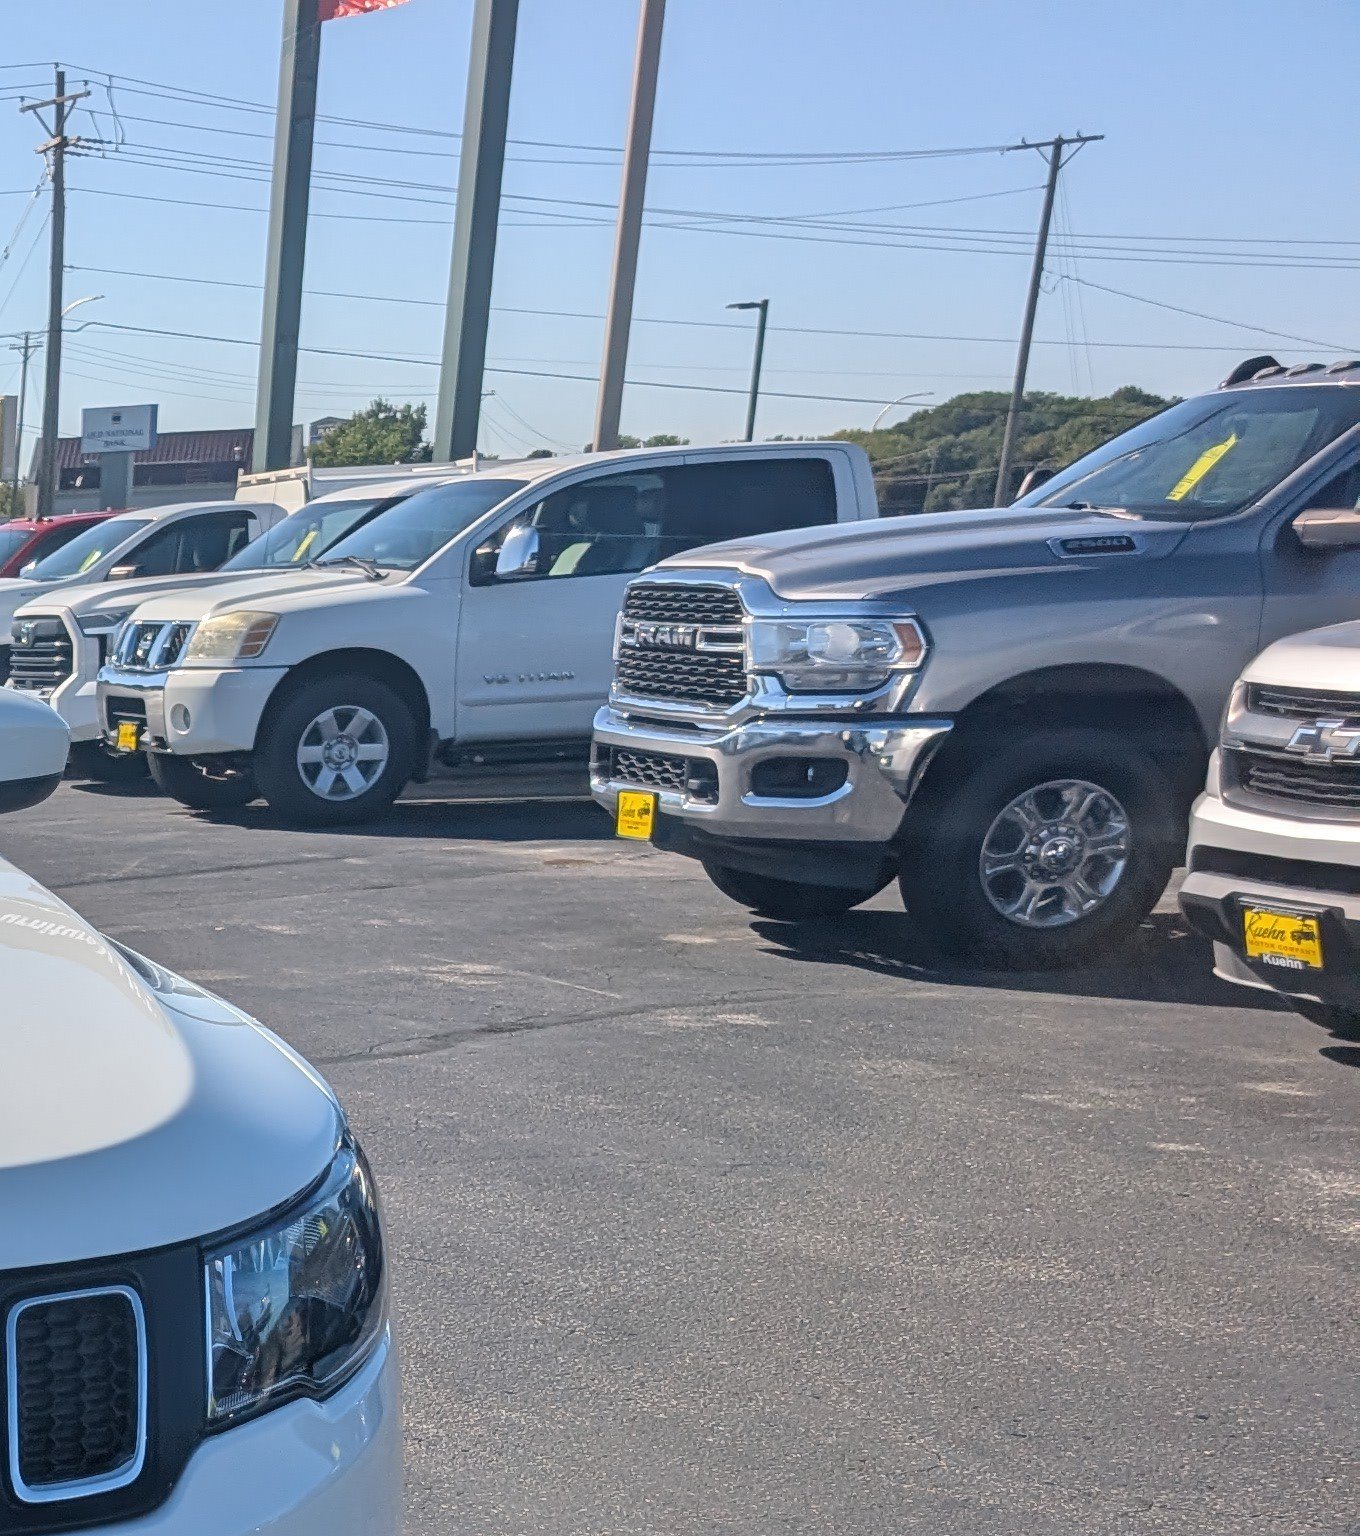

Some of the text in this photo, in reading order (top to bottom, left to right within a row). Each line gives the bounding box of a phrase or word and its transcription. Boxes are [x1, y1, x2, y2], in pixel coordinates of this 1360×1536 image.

[634, 623, 694, 648] RAM
[1245, 913, 1286, 942] Kuehn
[1262, 952, 1302, 970] Kuehn
